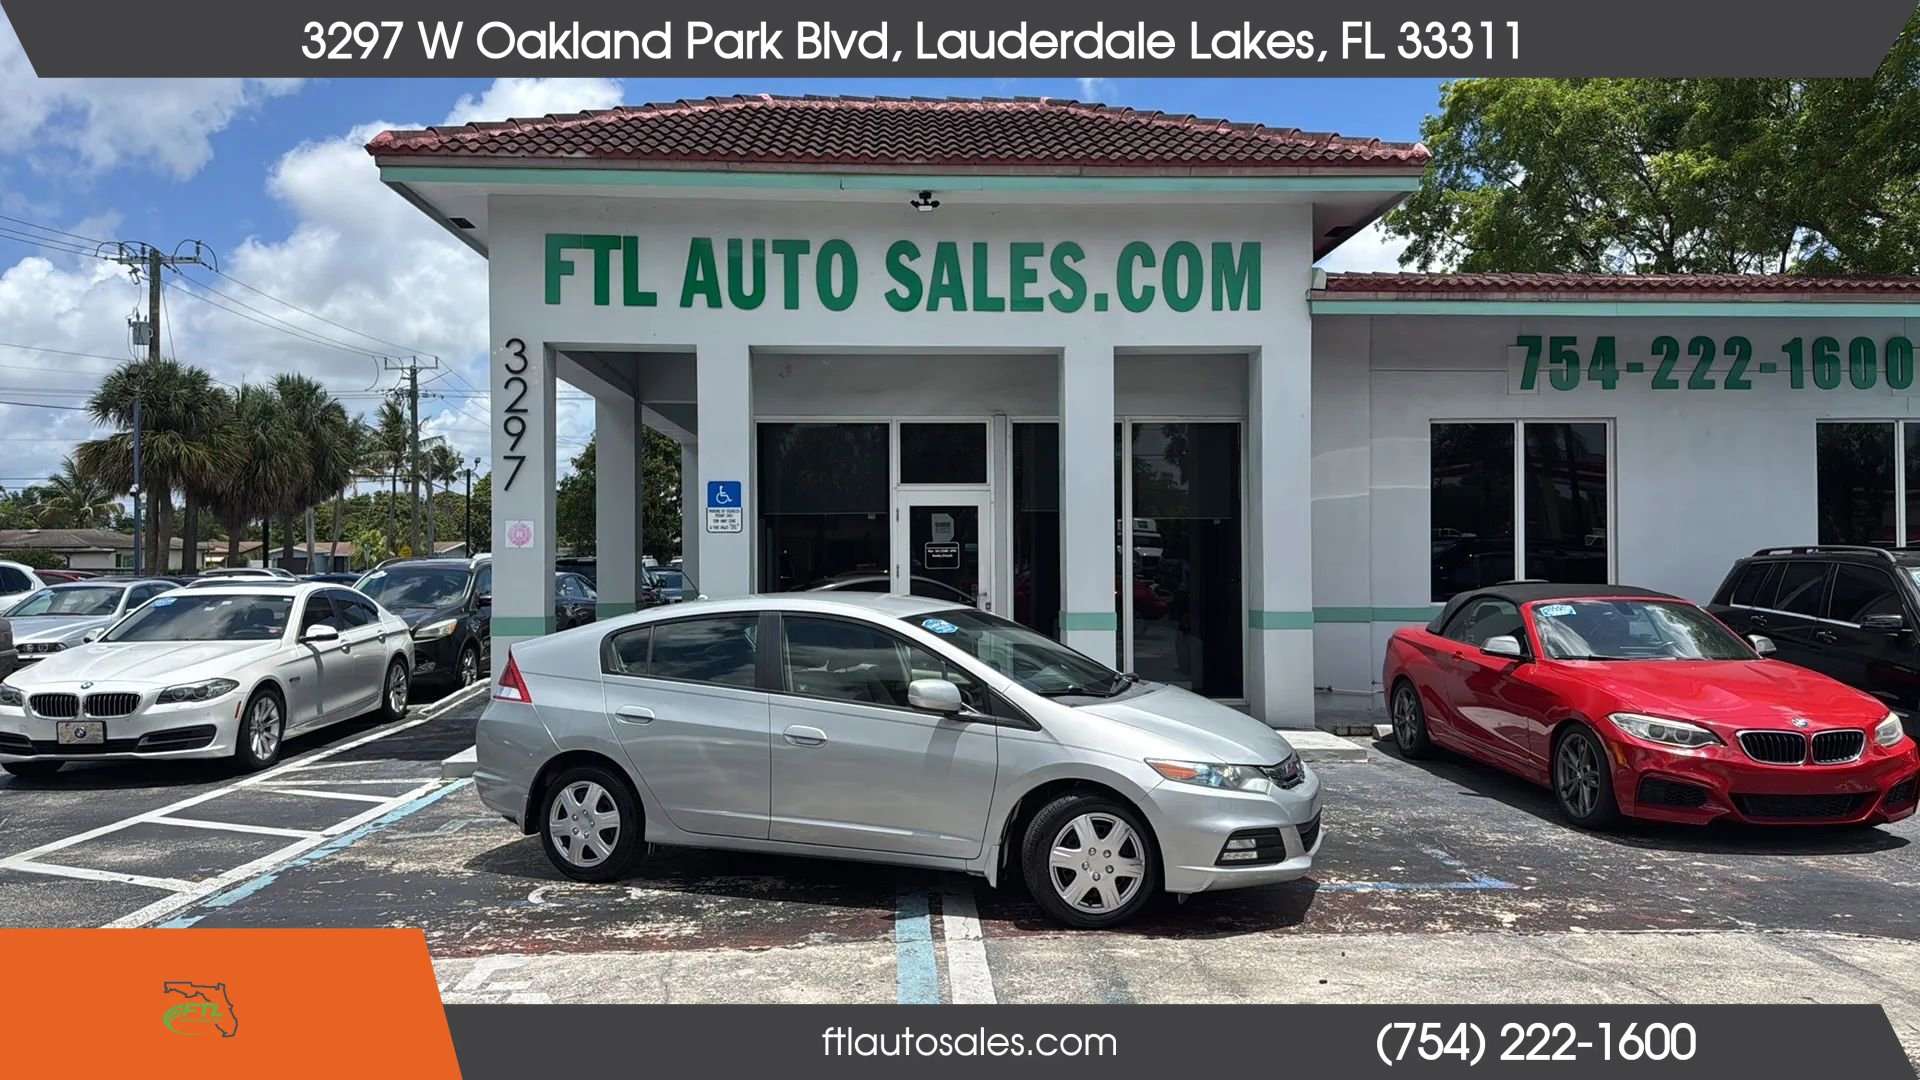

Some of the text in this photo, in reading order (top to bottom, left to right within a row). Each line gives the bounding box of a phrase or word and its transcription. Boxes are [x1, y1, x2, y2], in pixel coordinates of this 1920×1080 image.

[544, 234, 1263, 314] FTL AUTO SALES.COM
[1516, 335, 1914, 391] 754-222-1600
[503, 337, 529, 492] 3297
